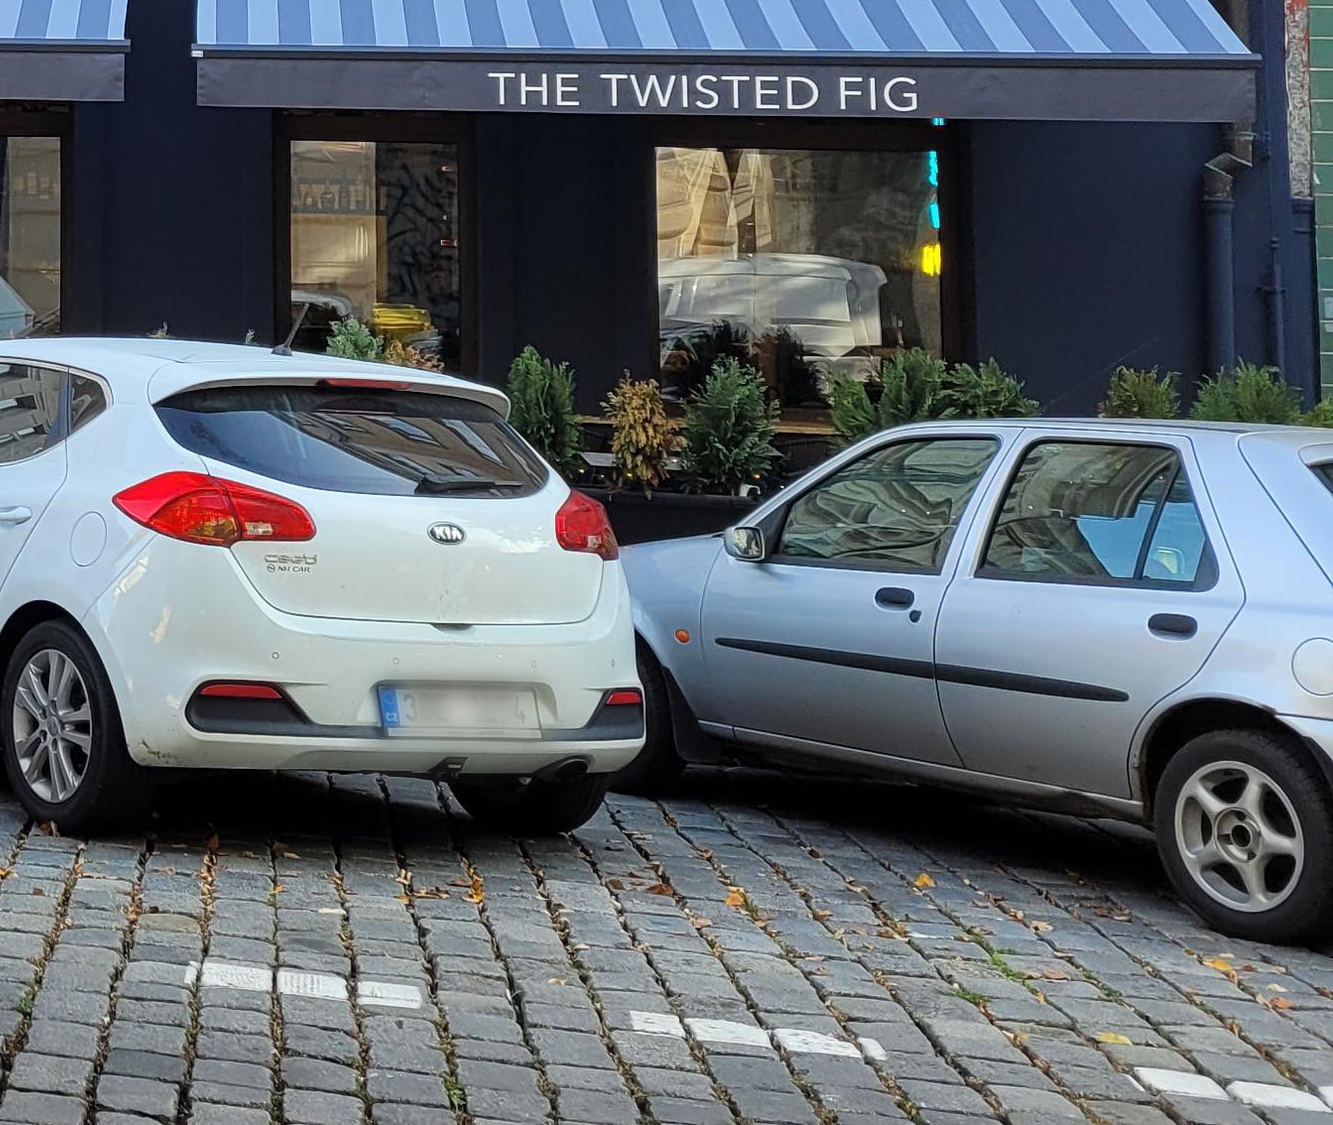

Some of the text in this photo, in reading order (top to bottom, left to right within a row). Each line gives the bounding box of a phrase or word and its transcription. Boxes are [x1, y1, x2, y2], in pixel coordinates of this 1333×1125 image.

[487, 71, 920, 113] THE TWISTED FIG
[434, 525, 463, 541] KIA
